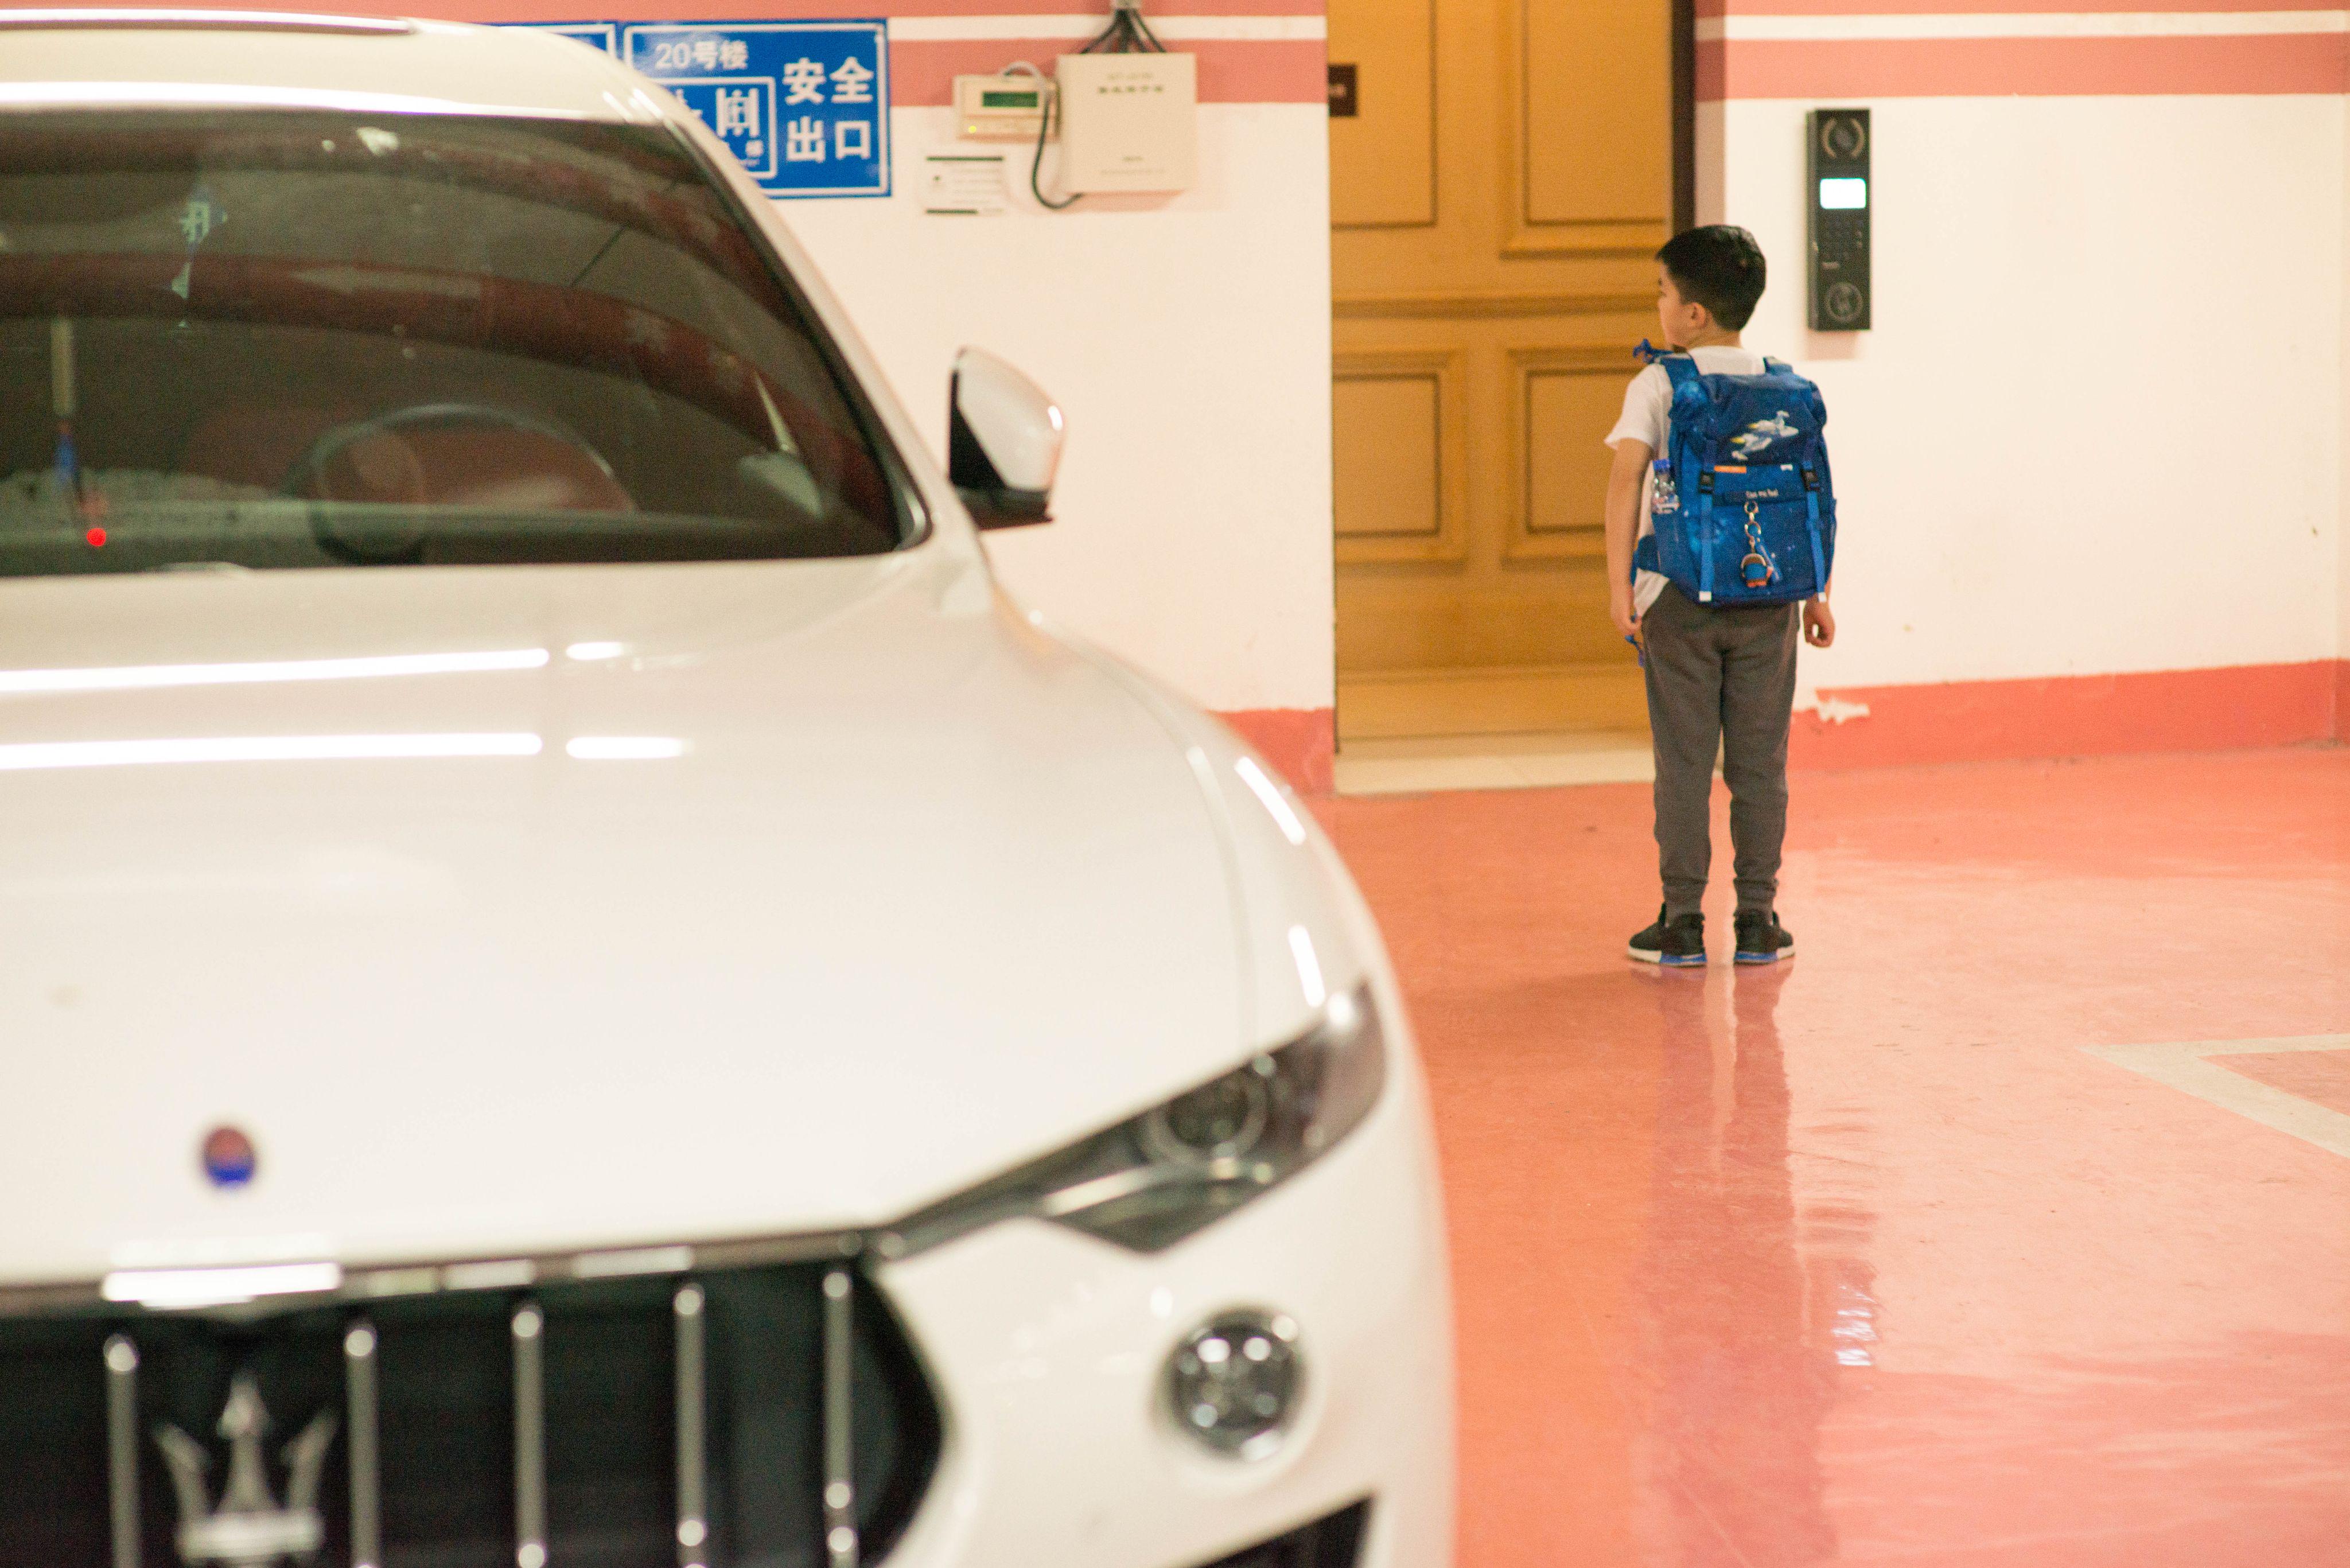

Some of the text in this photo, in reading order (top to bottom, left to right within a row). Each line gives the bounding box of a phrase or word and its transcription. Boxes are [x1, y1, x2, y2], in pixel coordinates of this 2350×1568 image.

[655, 40, 748, 69] 20号楼
[782, 57, 874, 106] 安全
[787, 116, 871, 163] 出口
